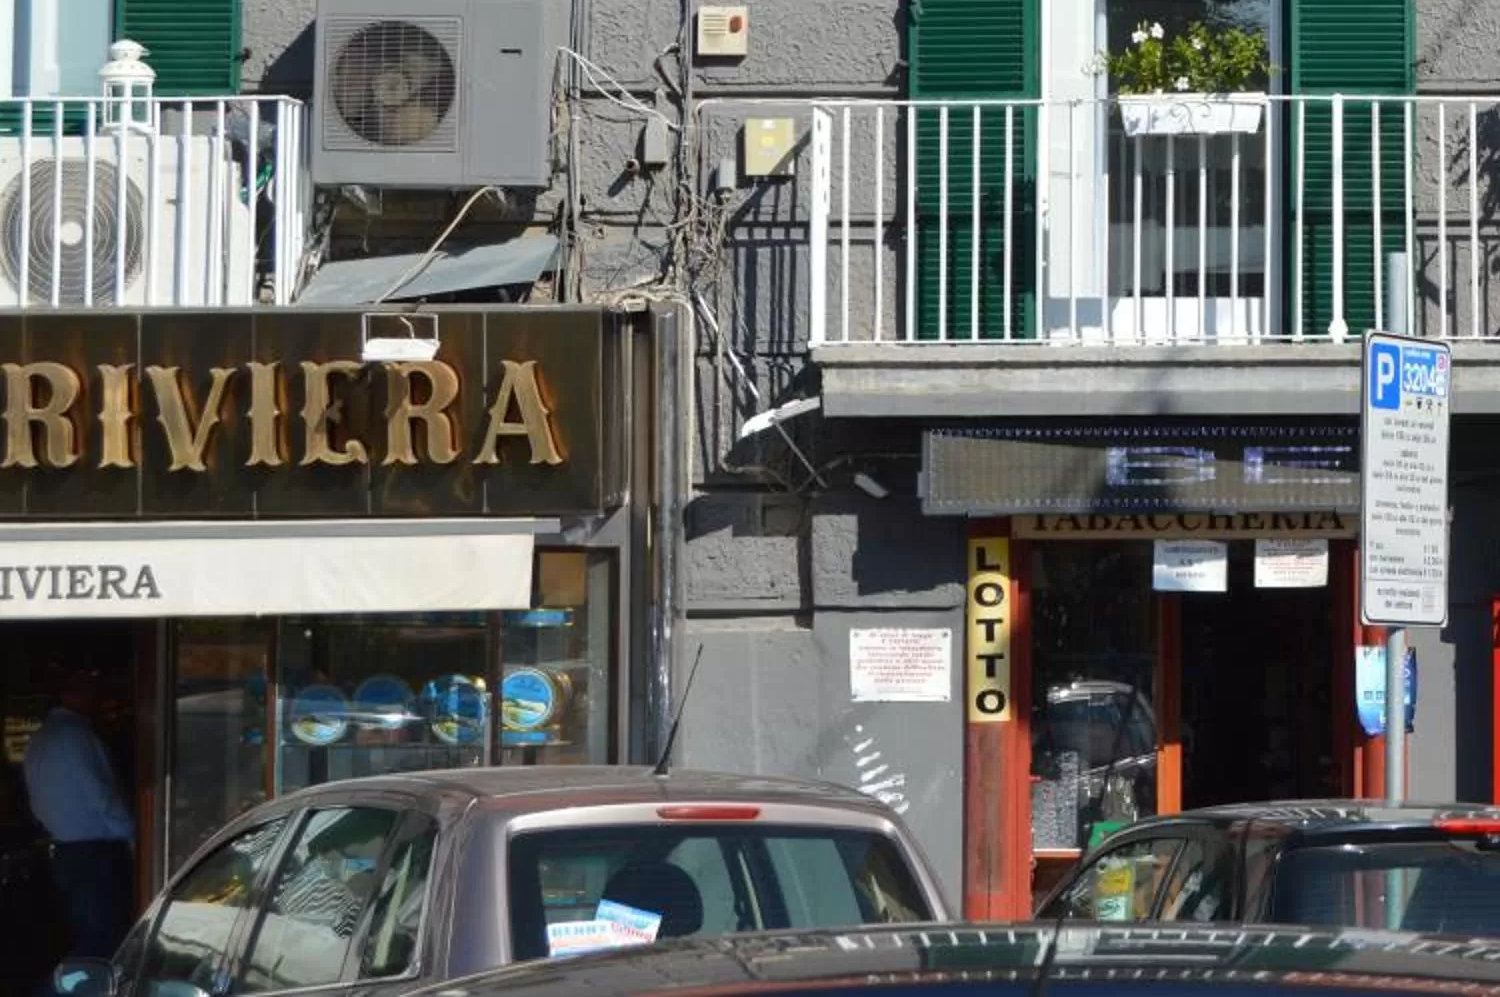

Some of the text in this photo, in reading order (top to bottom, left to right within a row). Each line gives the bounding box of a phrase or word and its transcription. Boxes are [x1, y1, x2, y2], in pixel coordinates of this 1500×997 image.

[1376, 351, 1395, 401] P
[0, 359, 564, 472] RIVIERA
[1033, 512, 1346, 532] TABACCHERIA
[0, 565, 162, 600] IVIERA
[974, 546, 1006, 715] LOTTO
